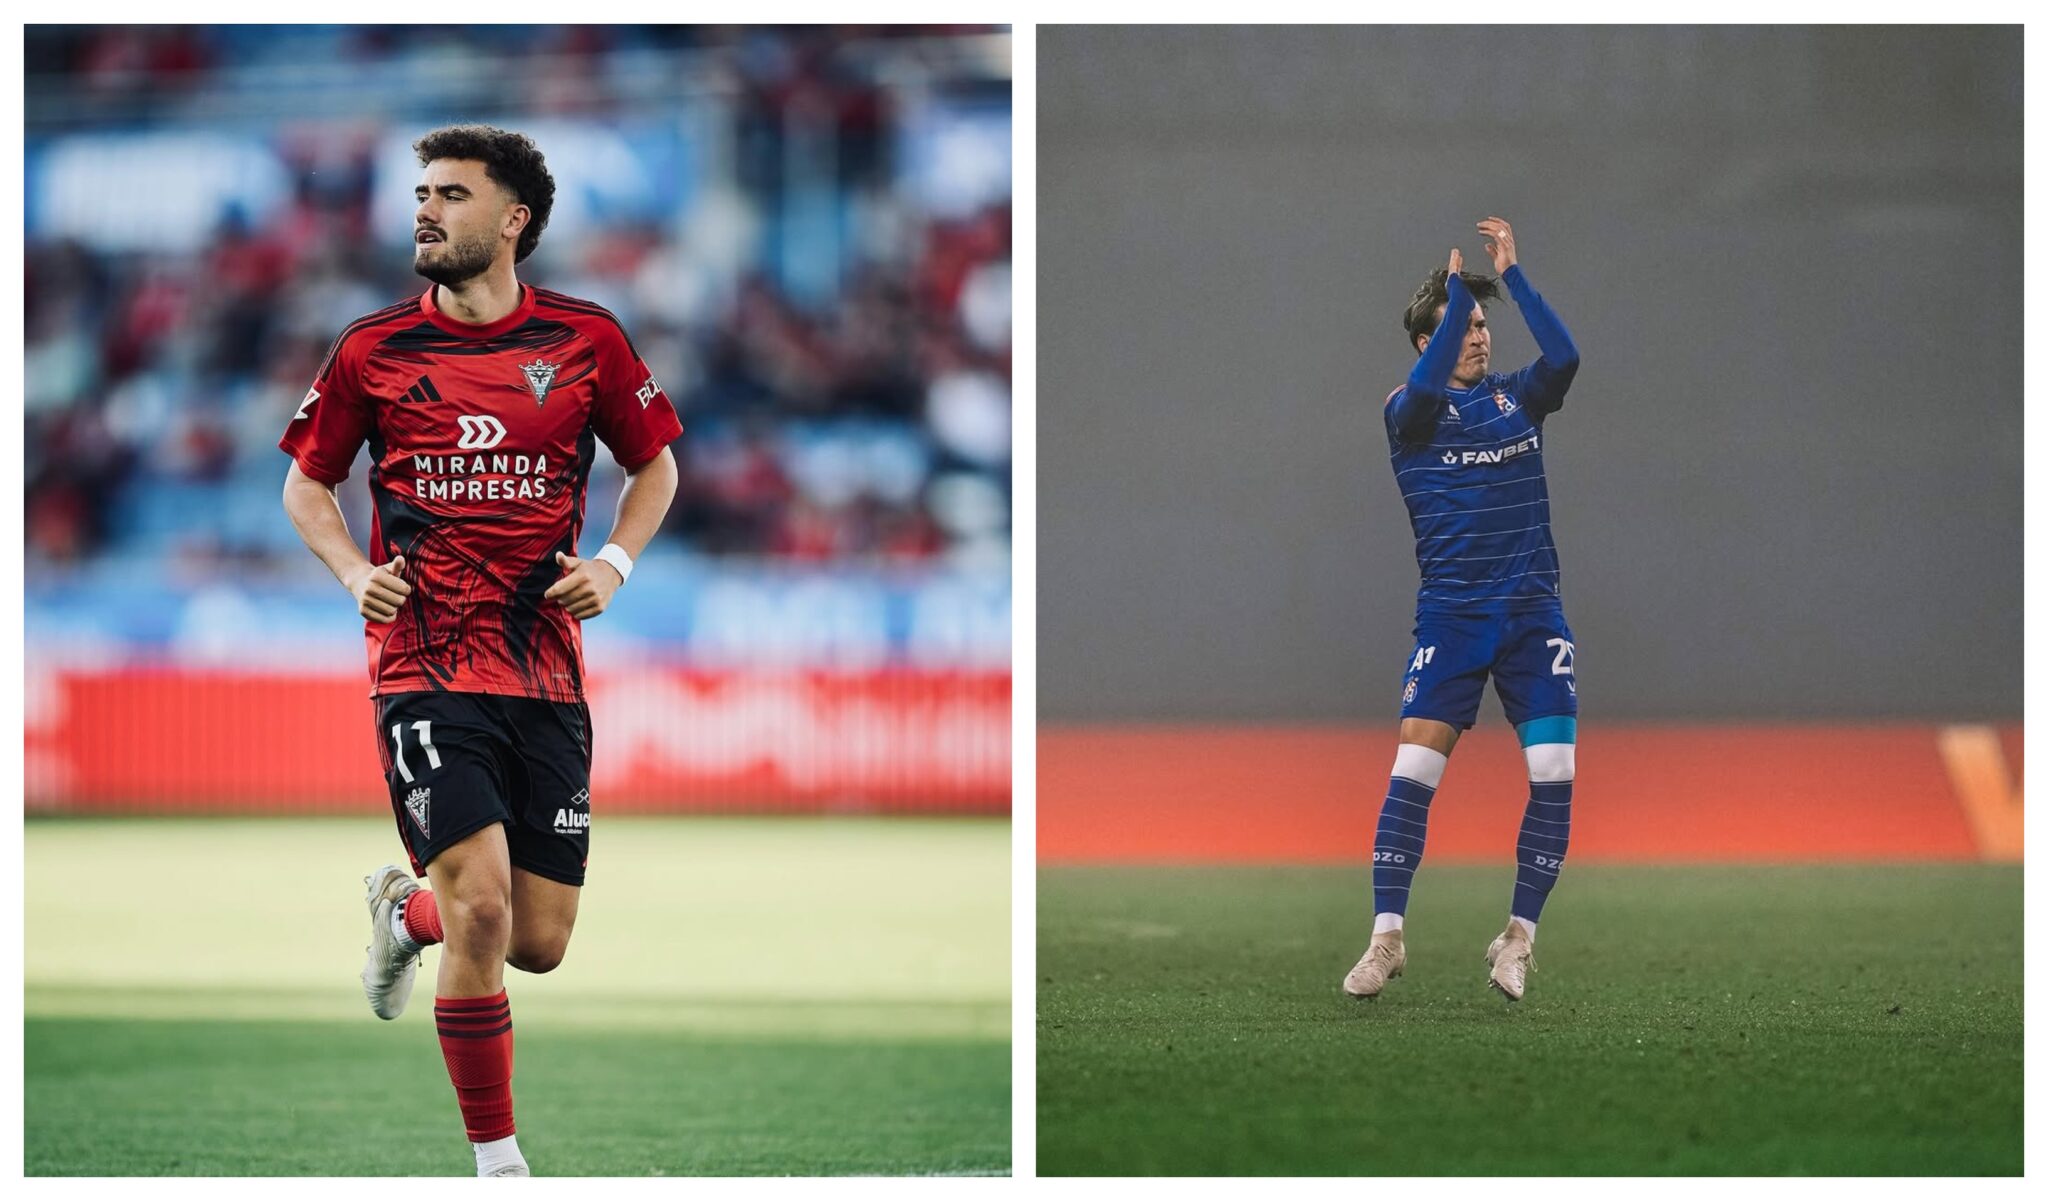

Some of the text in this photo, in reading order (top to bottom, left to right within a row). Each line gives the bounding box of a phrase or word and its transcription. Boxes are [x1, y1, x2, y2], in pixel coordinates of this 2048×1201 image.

[1462, 435, 1539, 465] FAVBET
[413, 454, 547, 475] MIRANDA
[415, 477, 547, 500] EMPRESAS
[1409, 646, 1436, 672] A1
[392, 720, 442, 783] 11
